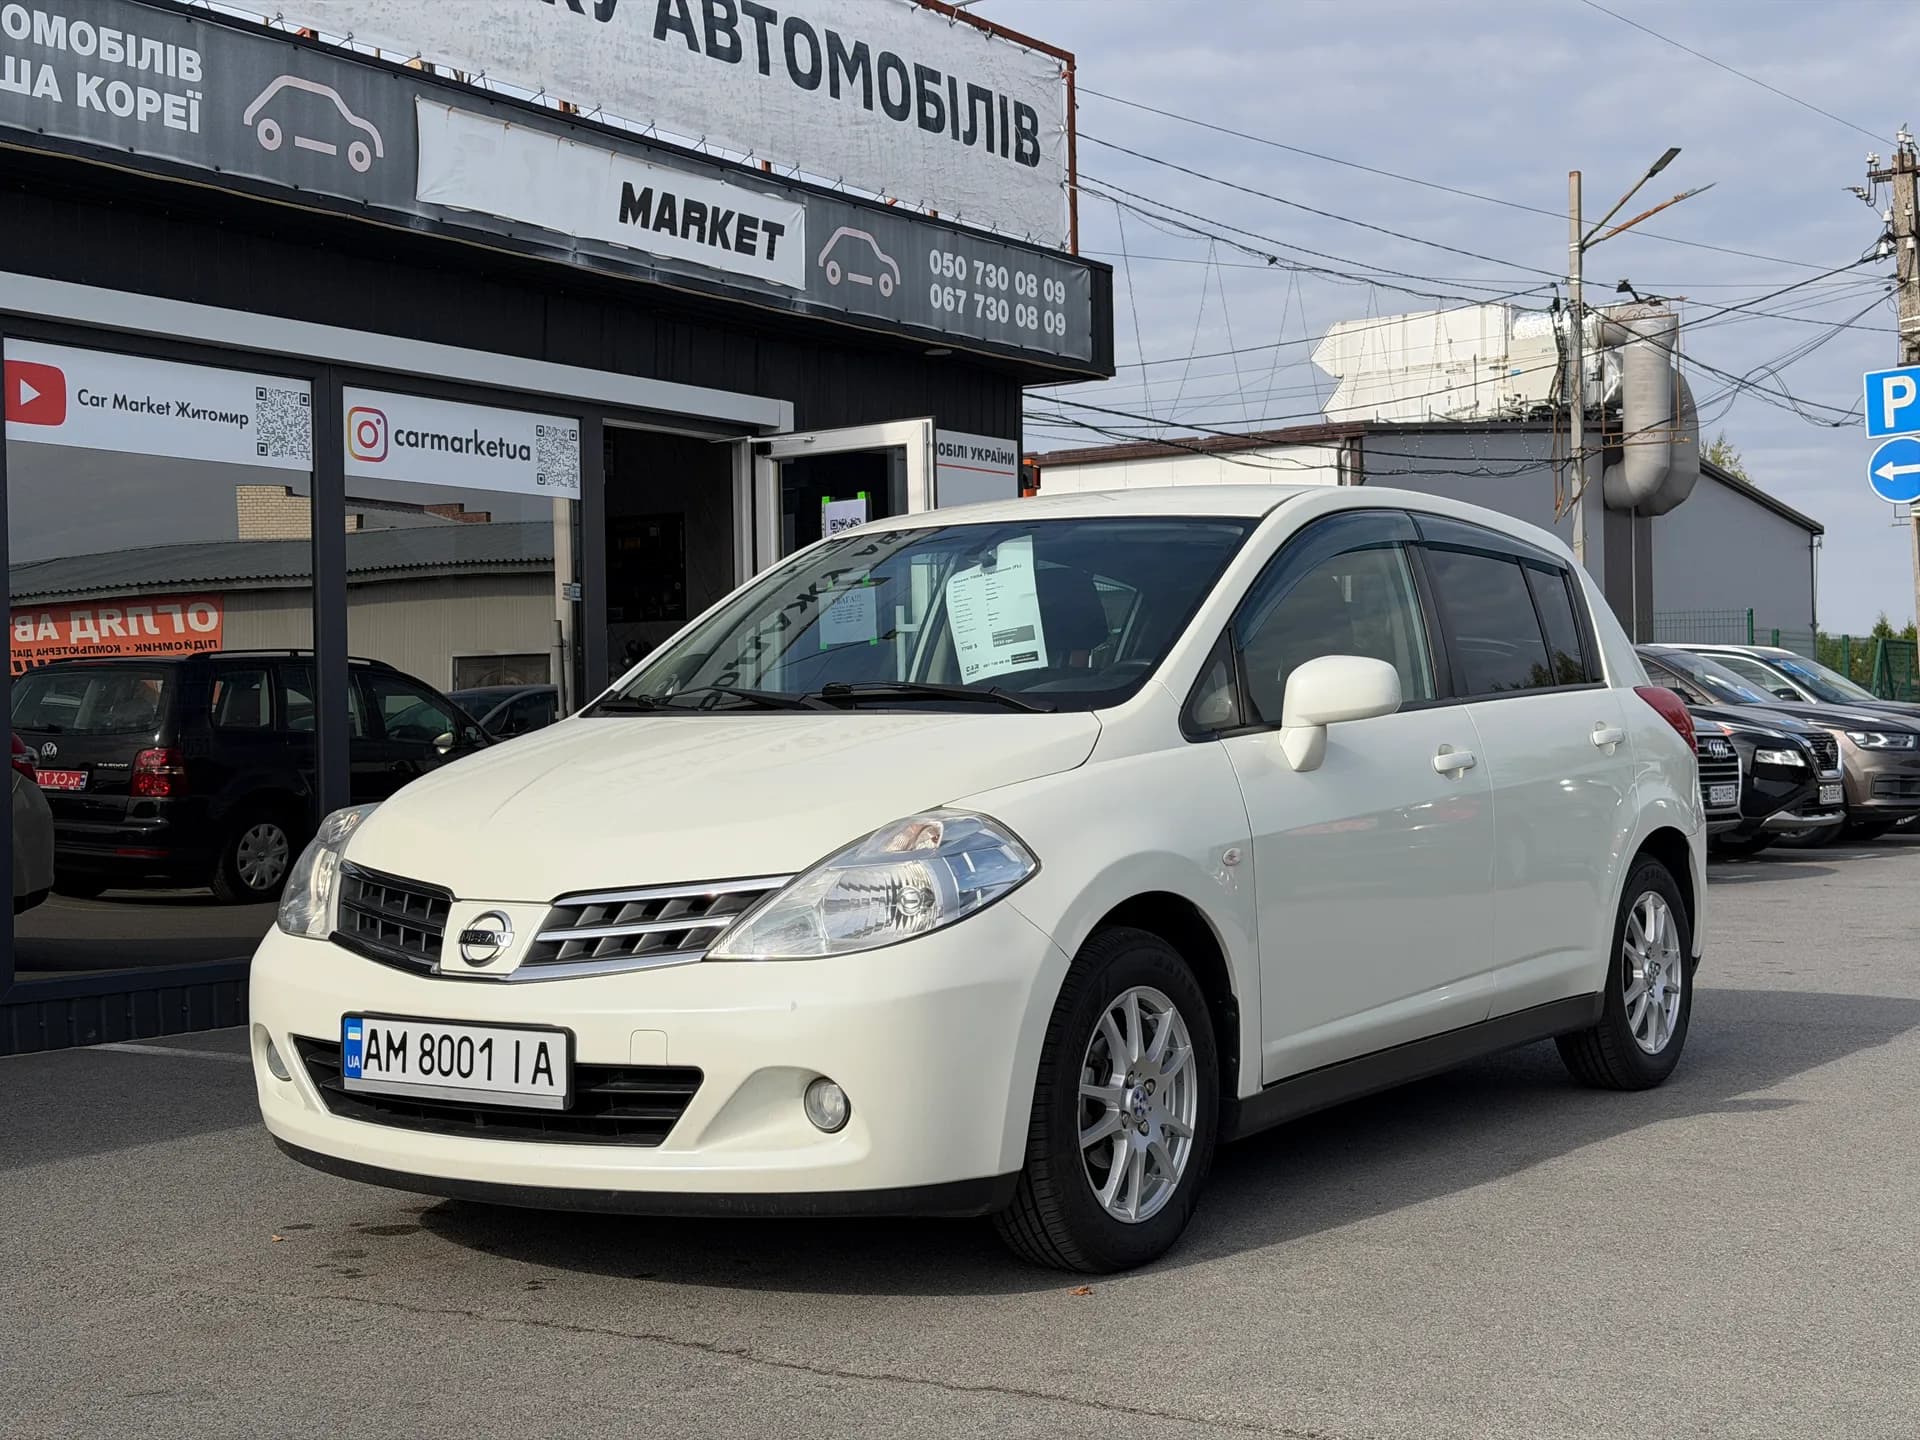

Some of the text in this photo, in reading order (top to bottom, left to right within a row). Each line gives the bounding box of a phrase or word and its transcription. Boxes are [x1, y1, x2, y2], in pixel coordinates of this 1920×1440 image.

[1, 3, 202, 82] ОМОБІЛІВ
[76, 71, 203, 134] КОРЕЇ
[653, 0, 1041, 168] АВТОМОБІЛІВ
[619, 181, 785, 260] MARKET
[929, 249, 1066, 304] 050 730 08 09
[929, 283, 1066, 336] 067 730 08 09
[77, 389, 249, 429] Car Market Житомир
[1882, 375, 1917, 428] P
[394, 429, 531, 461] carmarketua
[936, 441, 1015, 466] ОБІЛІ УКРАЇНИ
[347, 1055, 361, 1069] UA
[418, 1033, 493, 1081] 8001
